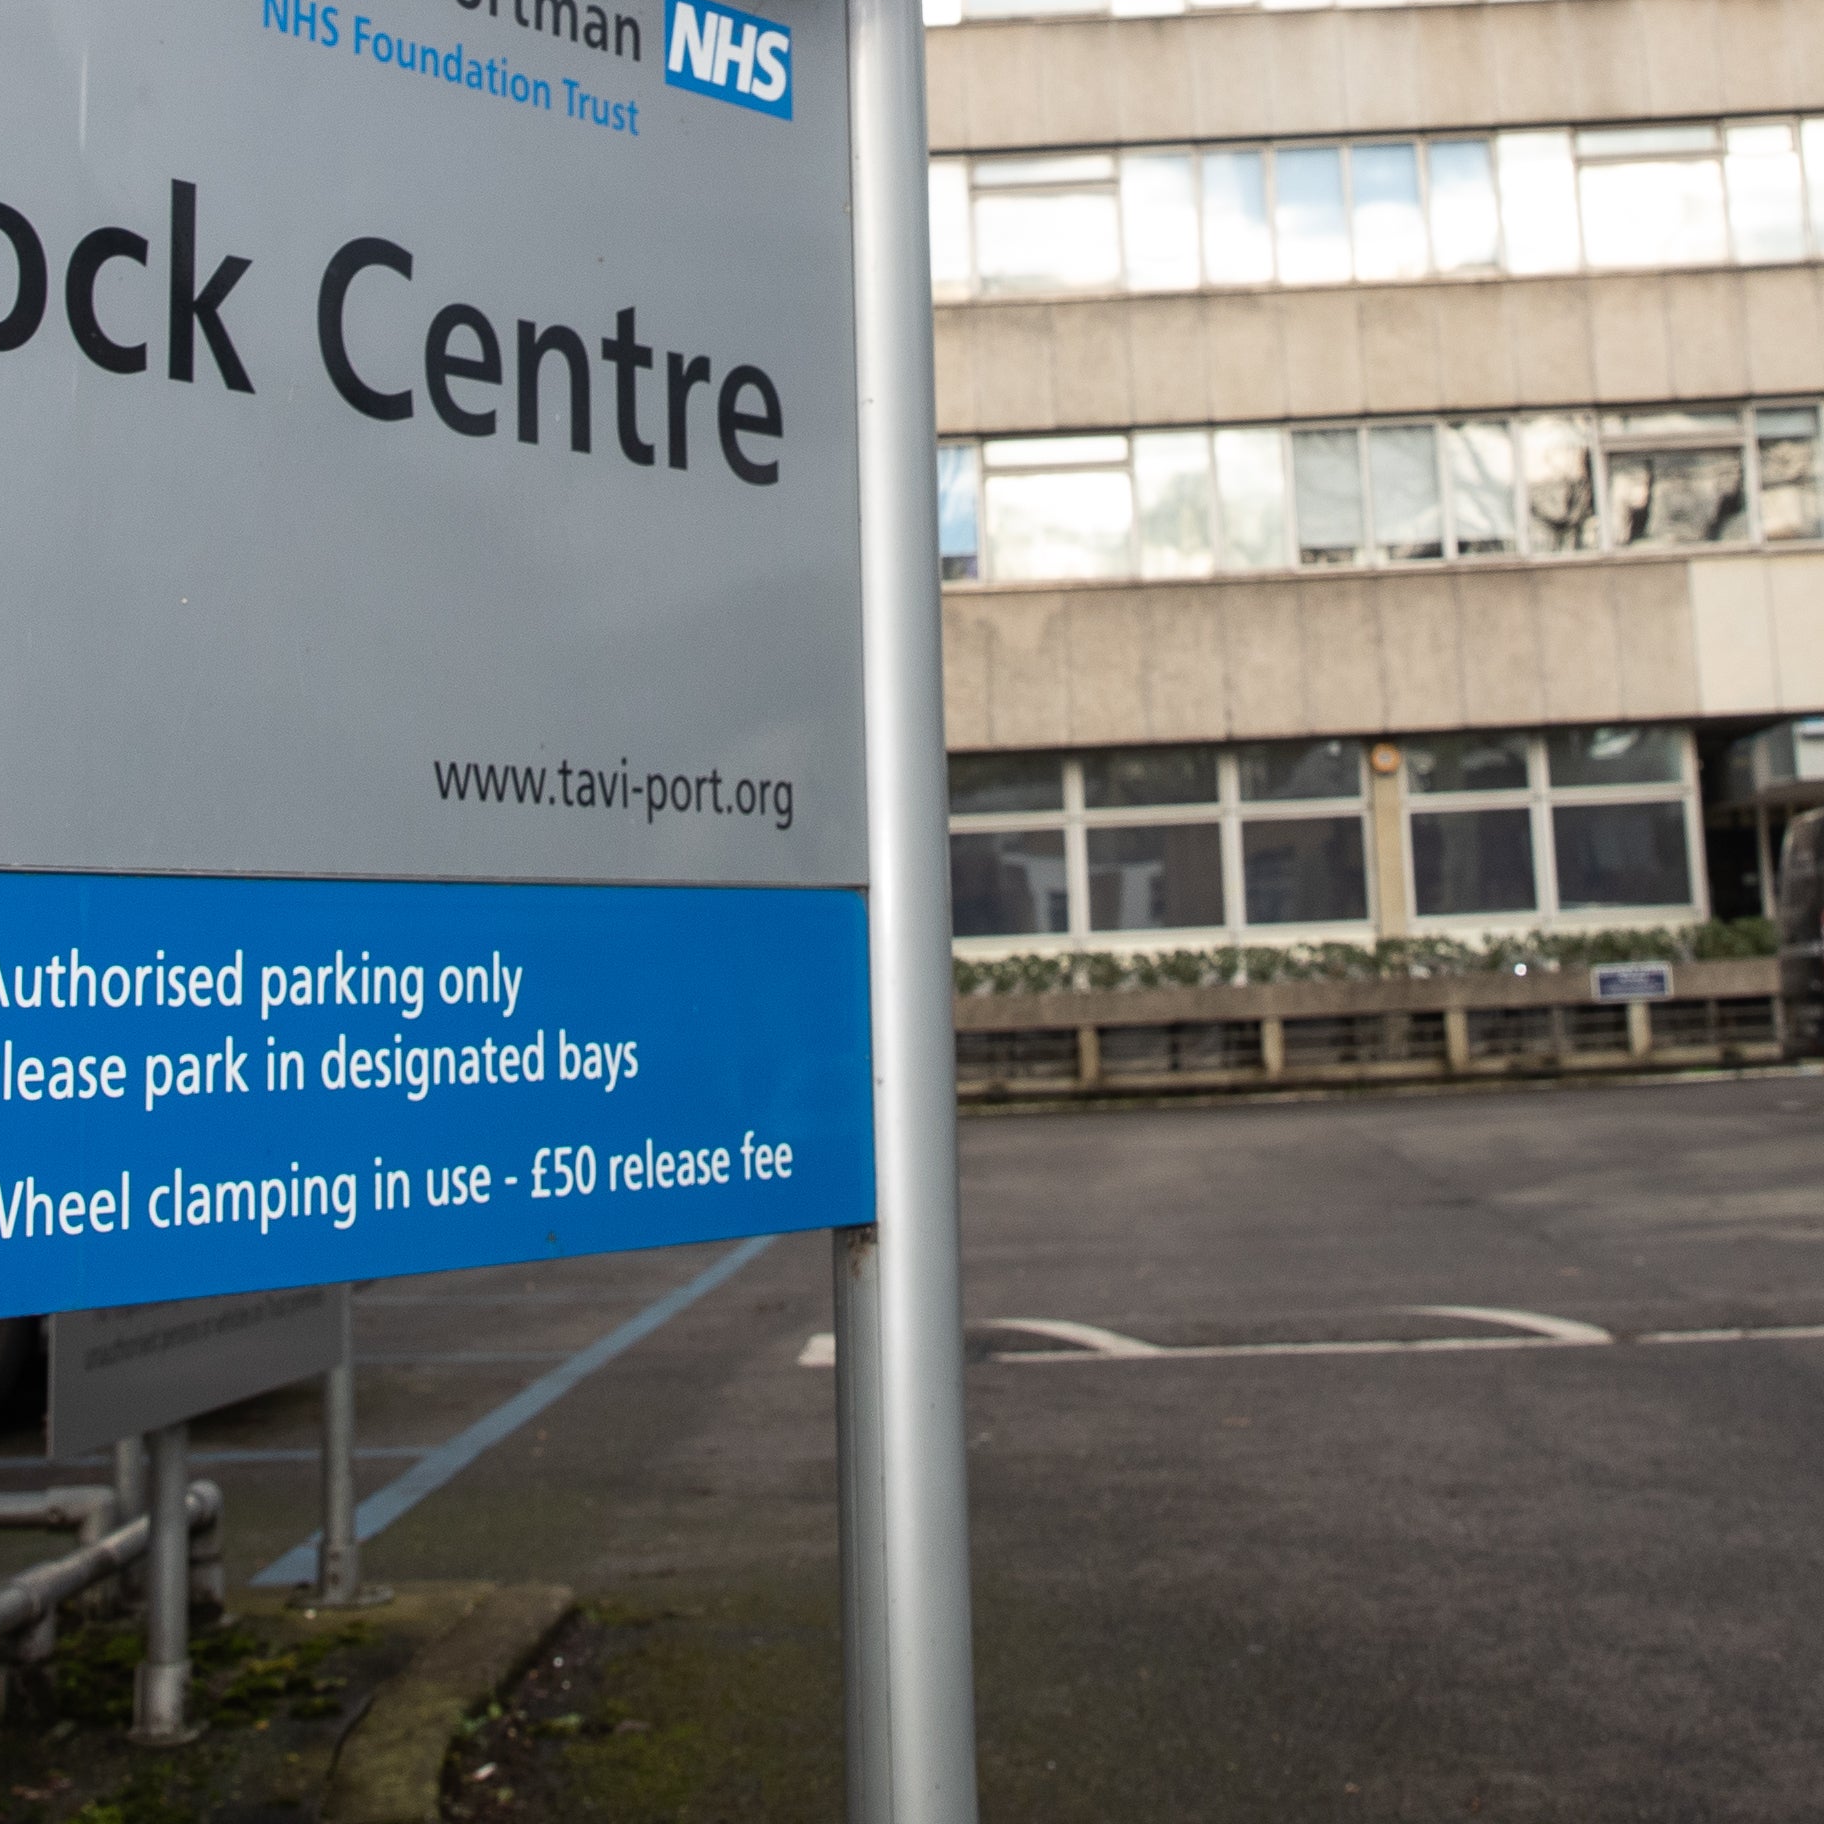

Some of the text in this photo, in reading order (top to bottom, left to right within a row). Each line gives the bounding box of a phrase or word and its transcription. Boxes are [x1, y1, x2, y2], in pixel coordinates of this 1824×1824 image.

[353, 15, 551, 110] Foundation
[561, 77, 639, 136] Trust
[668, 1, 790, 101] NHS
[317, 236, 785, 487] Centre
[433, 759, 794, 832] www.tavi-port.org
[260, 949, 424, 1021] parking
[438, 950, 523, 1018] only
[145, 1035, 250, 1112] park
[266, 1036, 306, 1092] in
[320, 1028, 545, 1102] designated
[558, 1028, 639, 1093] bays
[148, 1167, 357, 1235] clamping
[373, 1155, 410, 1211] in
[426, 1164, 492, 1207] use
[504, 1176, 518, 1185] -
[530, 1144, 597, 1199] £50
[609, 1138, 731, 1192] release
[739, 1130, 793, 1181] fee
